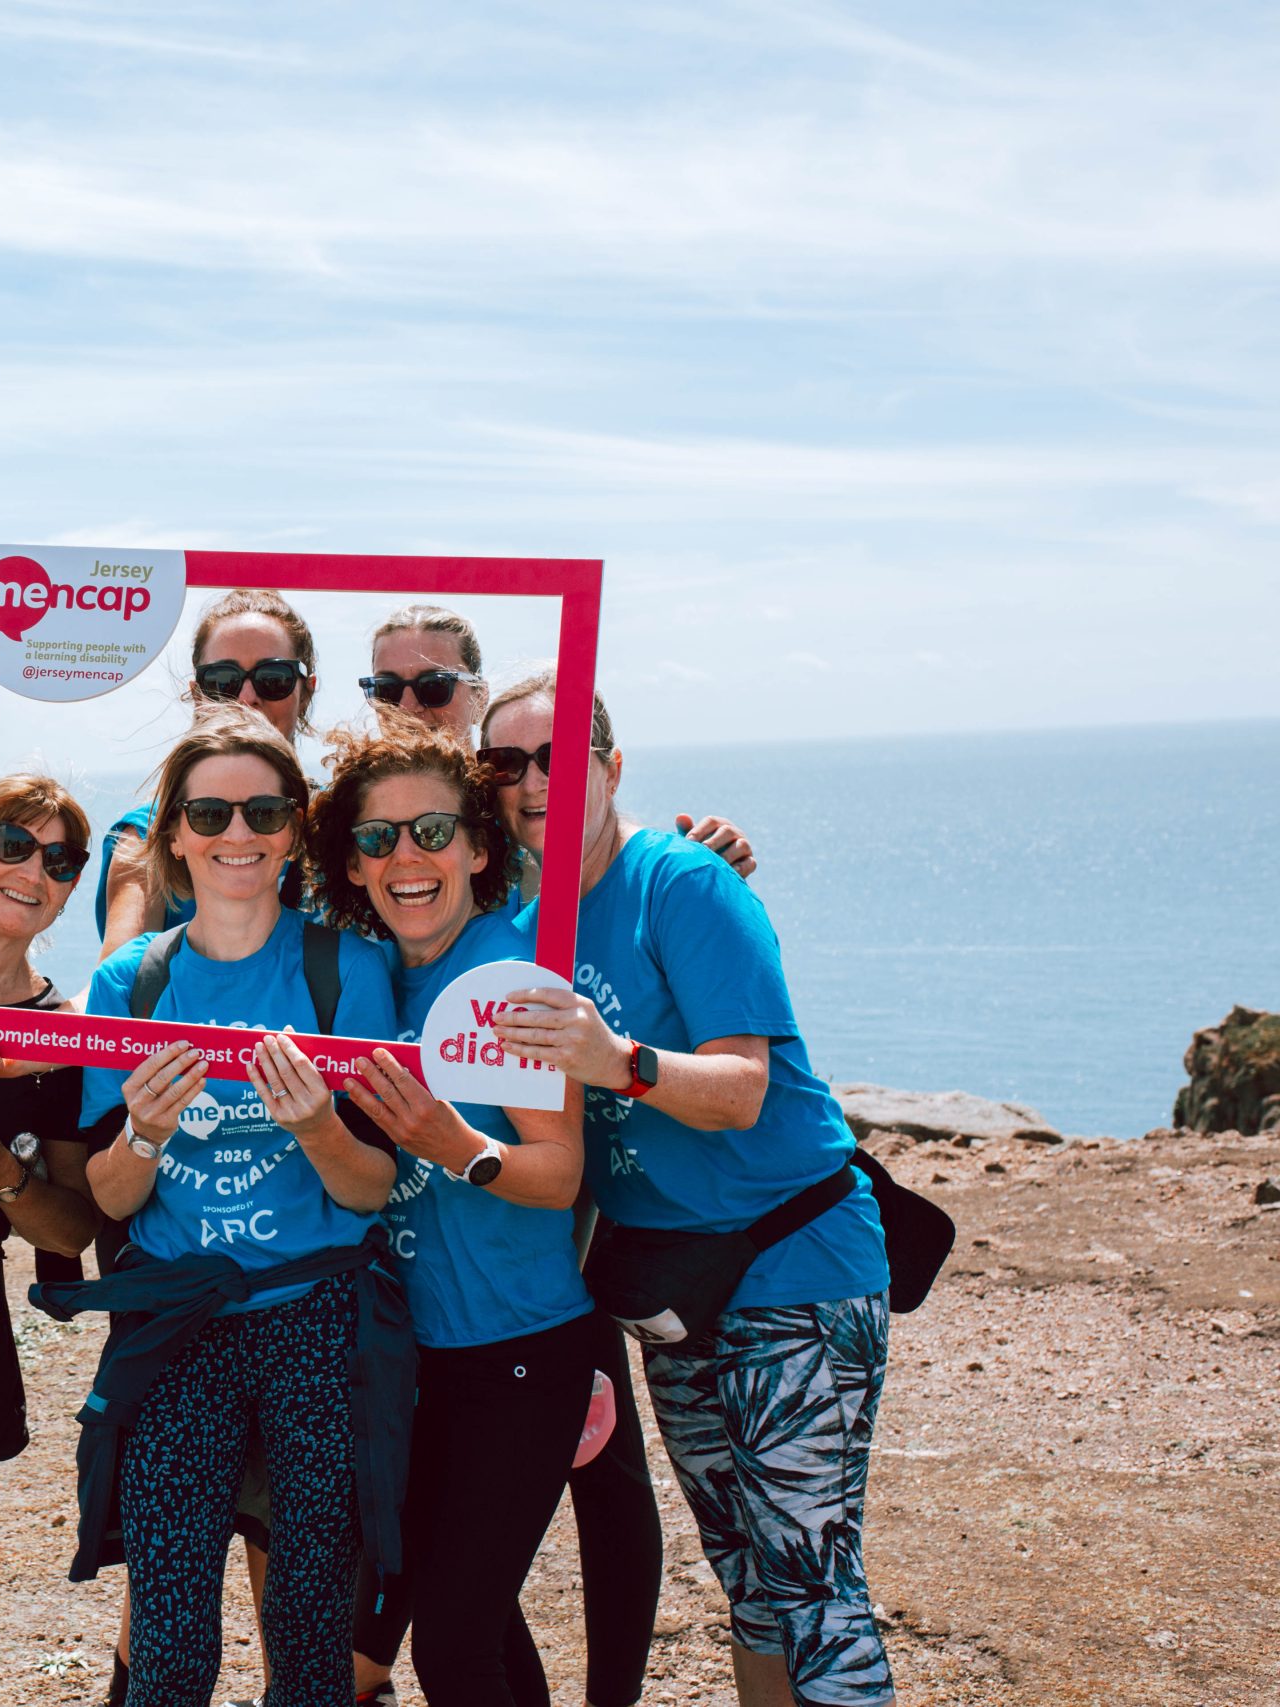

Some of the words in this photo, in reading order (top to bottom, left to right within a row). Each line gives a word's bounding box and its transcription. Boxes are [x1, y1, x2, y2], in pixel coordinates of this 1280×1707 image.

[90, 560, 154, 584] Jersey
[26, 639, 83, 654] Supporting
[85, 641, 121, 655] people
[123, 642, 147, 654] with
[25, 652, 32, 660] a
[34, 651, 78, 664] learning
[79, 653, 128, 666] disability
[23, 666, 124, 683] @jerseymencap
[576, 961, 622, 1016] OAST
[86, 1034, 117, 1052] the
[439, 1032, 506, 1066] did
[214, 1148, 253, 1163] 2026
[202, 1202, 247, 1214] SPONSORED
[246, 1200, 255, 1209] BY
[200, 1209, 278, 1249] ARC
